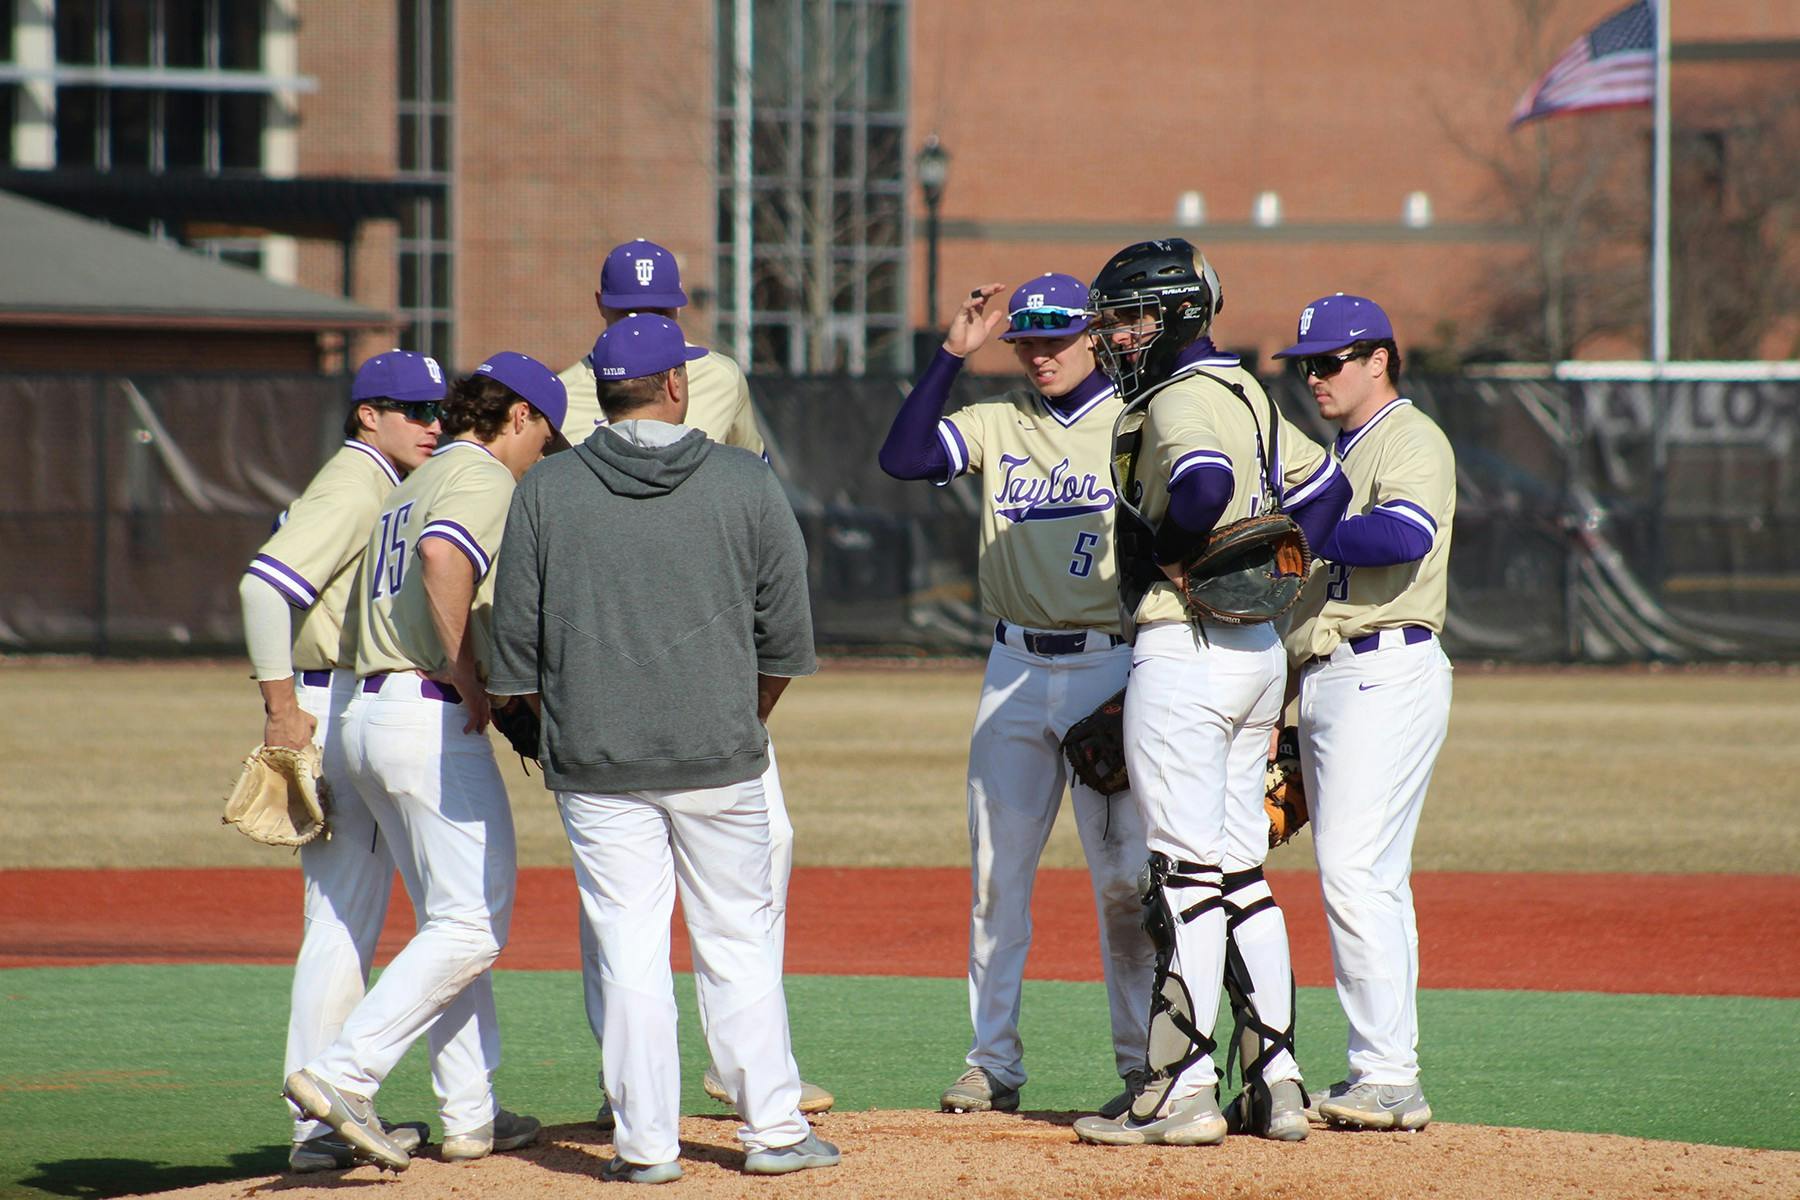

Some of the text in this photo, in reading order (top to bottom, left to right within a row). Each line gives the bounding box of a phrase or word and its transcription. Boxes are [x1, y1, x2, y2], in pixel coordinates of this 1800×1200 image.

[602, 367, 626, 376] TAYLOR
[994, 453, 1117, 523] Taylor
[372, 499, 417, 601] 15
[1067, 531, 1100, 578] 5
